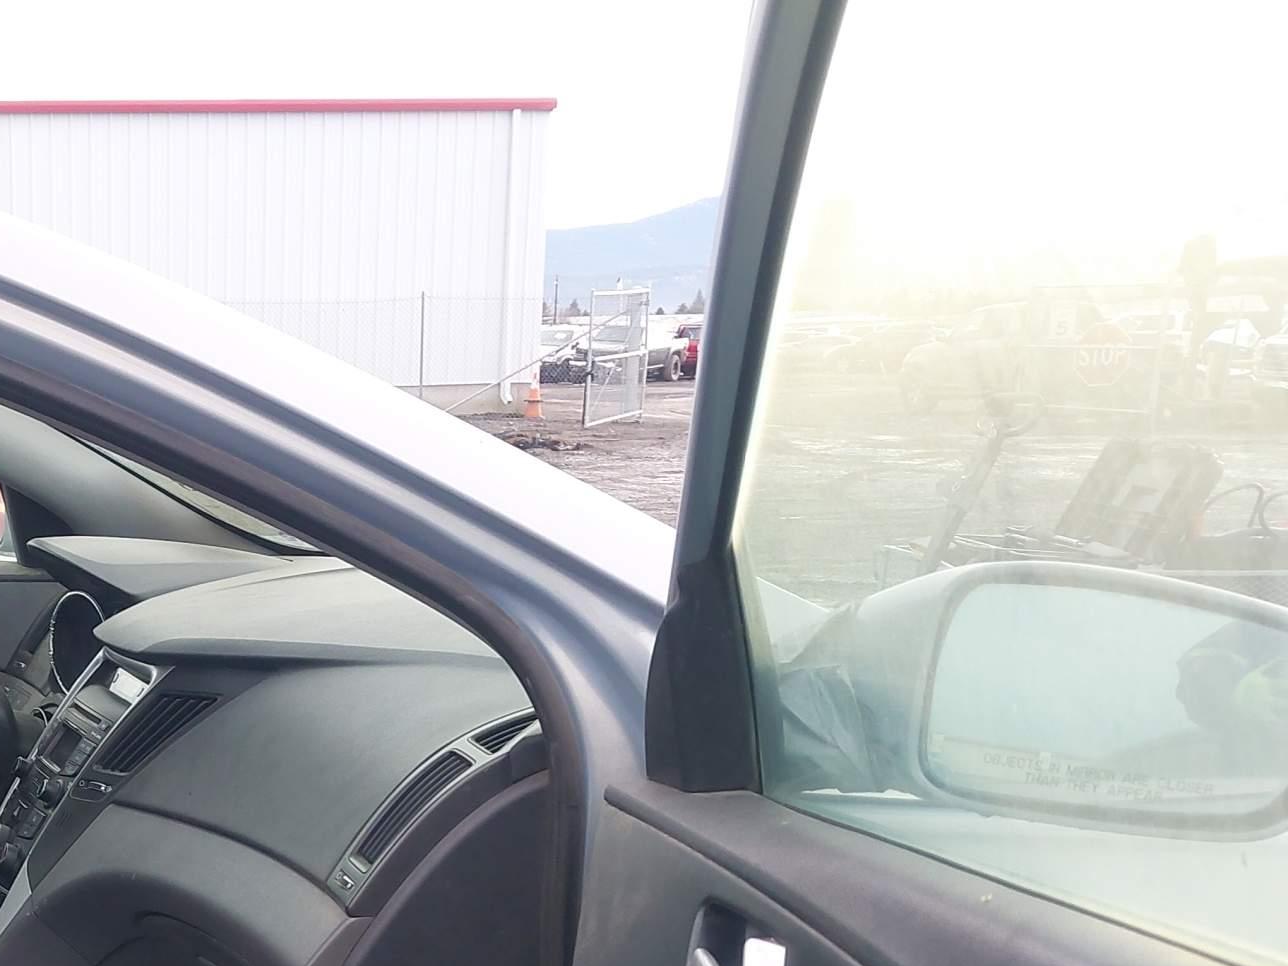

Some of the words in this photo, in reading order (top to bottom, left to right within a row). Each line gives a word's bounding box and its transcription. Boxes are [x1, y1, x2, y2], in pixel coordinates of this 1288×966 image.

[1078, 344, 1127, 367] STOP
[983, 752, 1042, 772] OBJECTS
[1065, 764, 1115, 783] MIRROR
[1121, 773, 1150, 787] ARE
[1159, 776, 1216, 796] CLOSER
[1024, 771, 1059, 787] THAN
[1066, 778, 1098, 793] THEY
[1107, 785, 1163, 801] APPEAR
